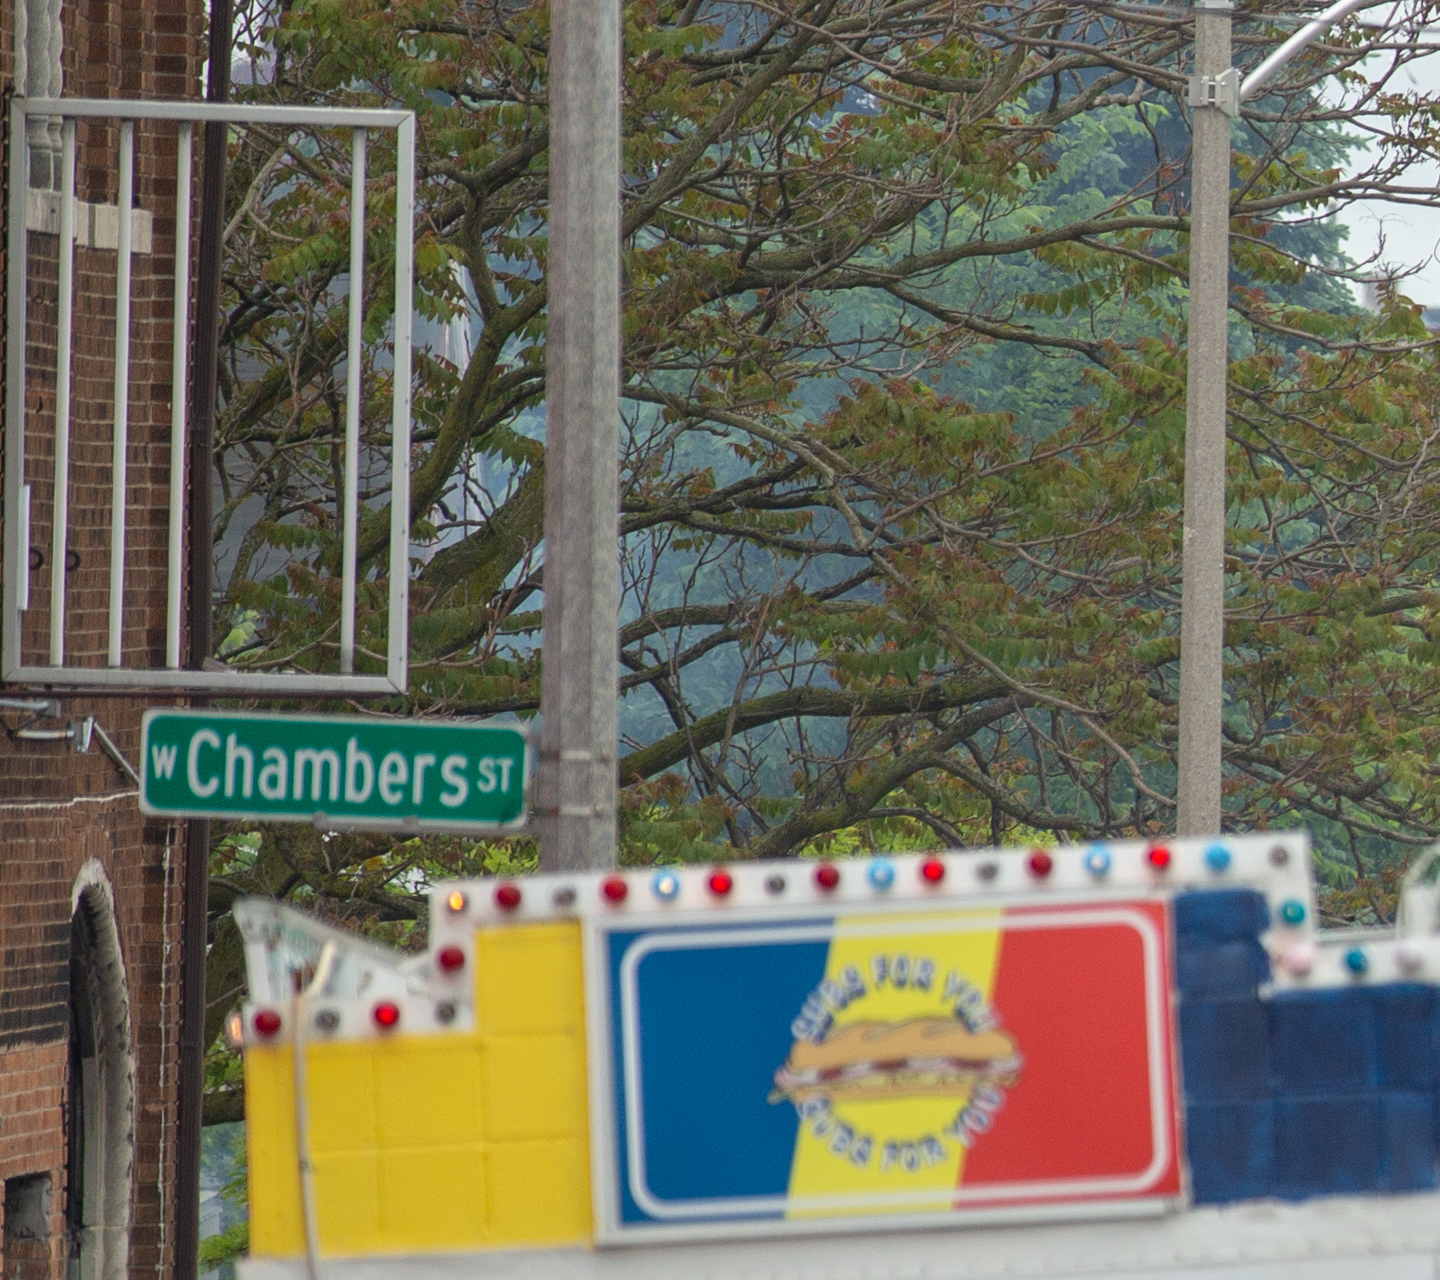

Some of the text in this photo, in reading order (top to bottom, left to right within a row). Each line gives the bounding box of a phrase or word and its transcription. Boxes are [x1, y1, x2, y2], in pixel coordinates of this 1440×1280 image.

[151, 727, 514, 808] W Chambers ST
[868, 954, 936, 993] FOR
[880, 1135, 946, 1173] FOR
